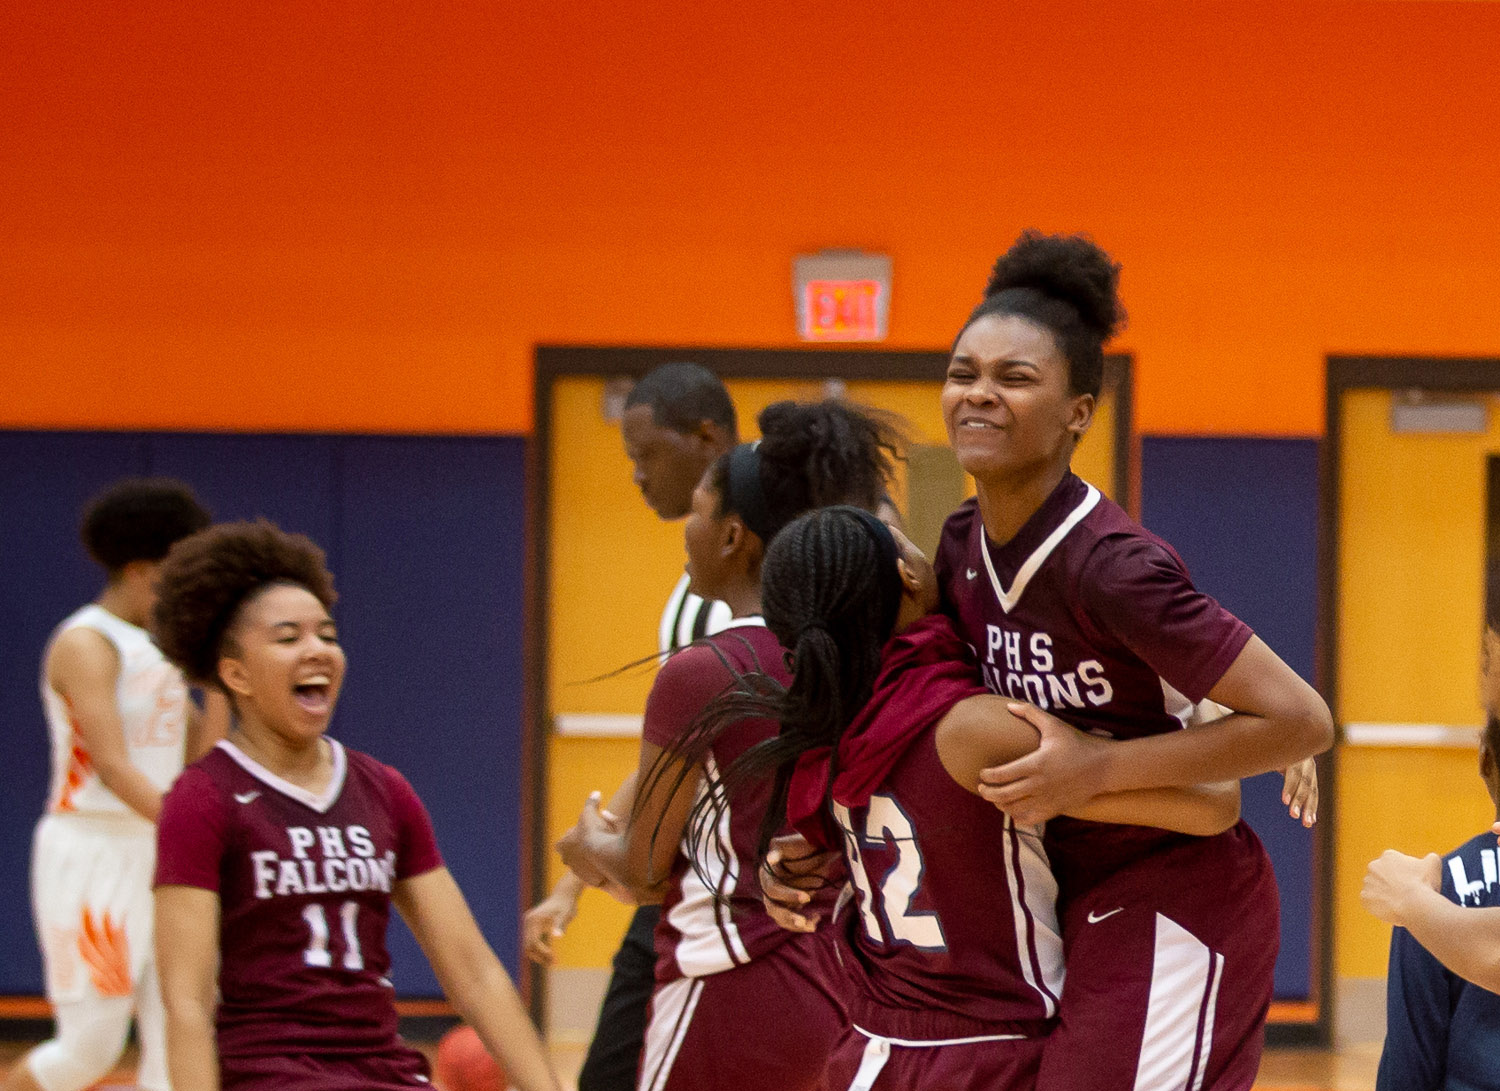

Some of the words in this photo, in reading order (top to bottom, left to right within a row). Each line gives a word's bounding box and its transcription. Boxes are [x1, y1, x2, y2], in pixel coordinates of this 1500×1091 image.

[986, 624, 1054, 672] PHS
[980, 659, 1113, 710] ALCONS
[287, 825, 376, 859] PHS
[302, 901, 365, 970] 11
